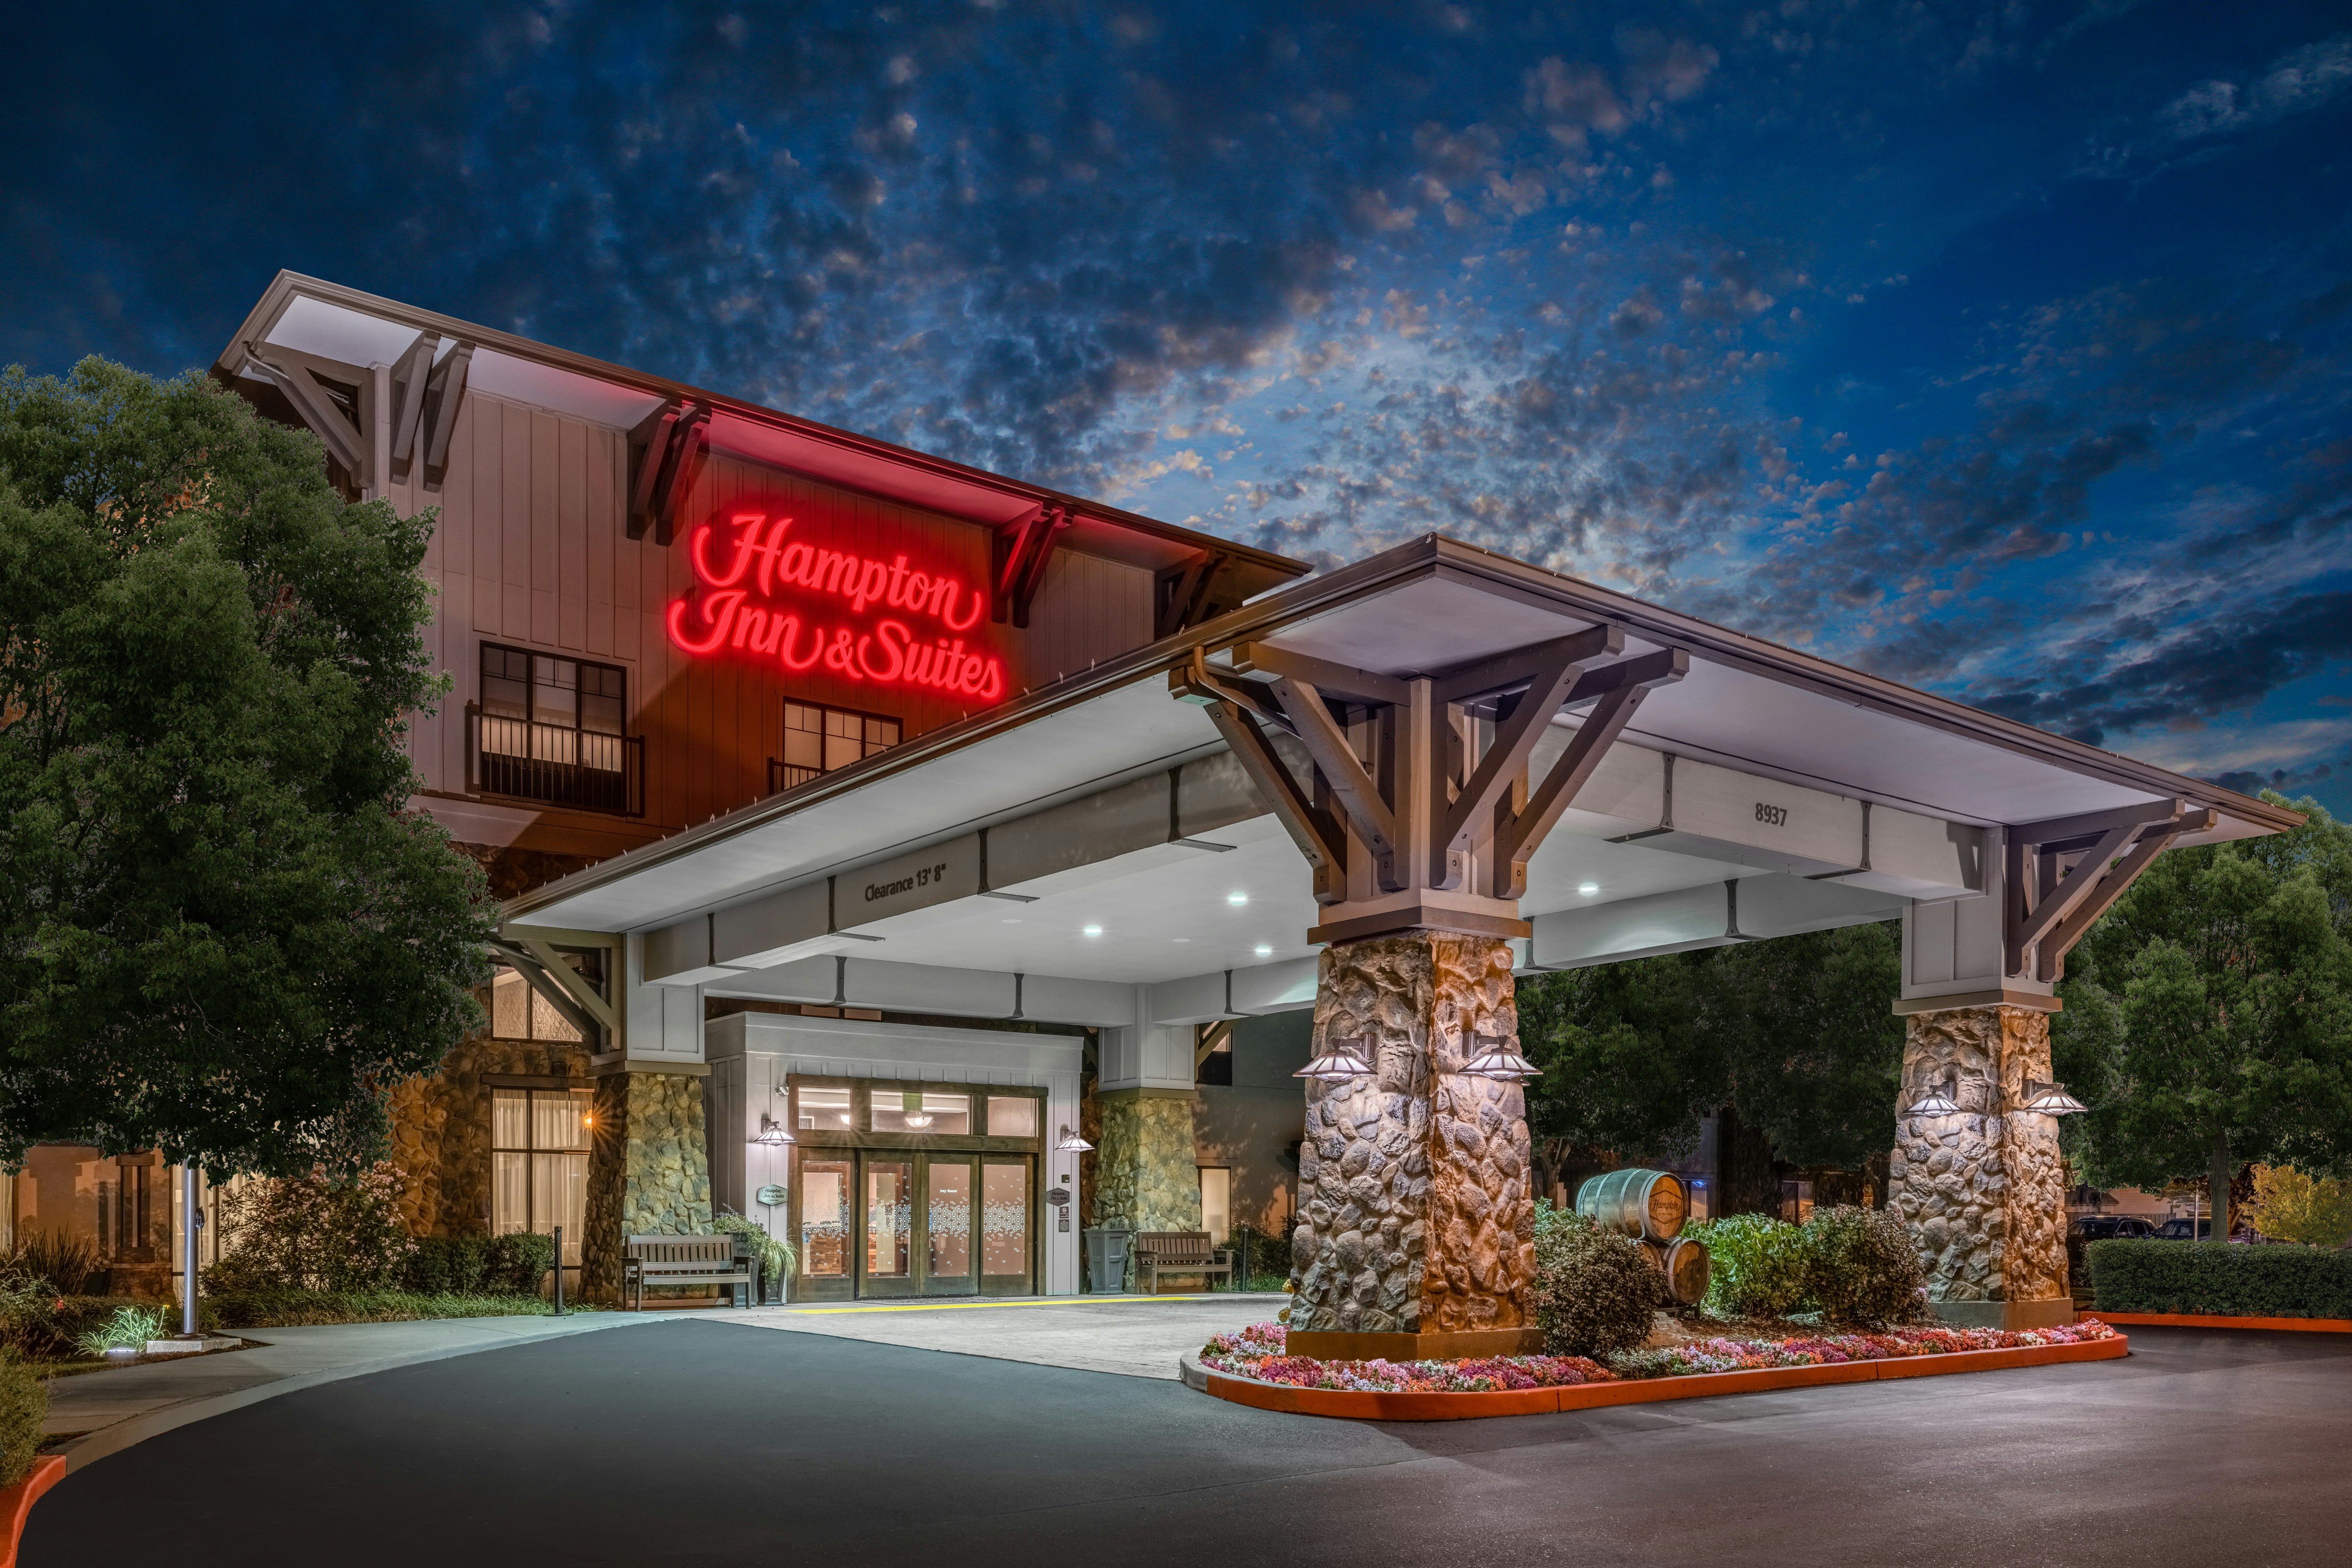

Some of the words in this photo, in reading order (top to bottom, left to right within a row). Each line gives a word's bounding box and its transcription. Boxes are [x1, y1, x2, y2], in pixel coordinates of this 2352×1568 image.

[693, 513, 982, 630] Hampton
[668, 590, 824, 670] Inn
[1755, 802, 1788, 827] 8937
[864, 877, 914, 902] Clearance
[916, 868, 931, 887] 13'
[934, 863, 946, 882] 8"
[1650, 1199, 1680, 1211] Hampton
